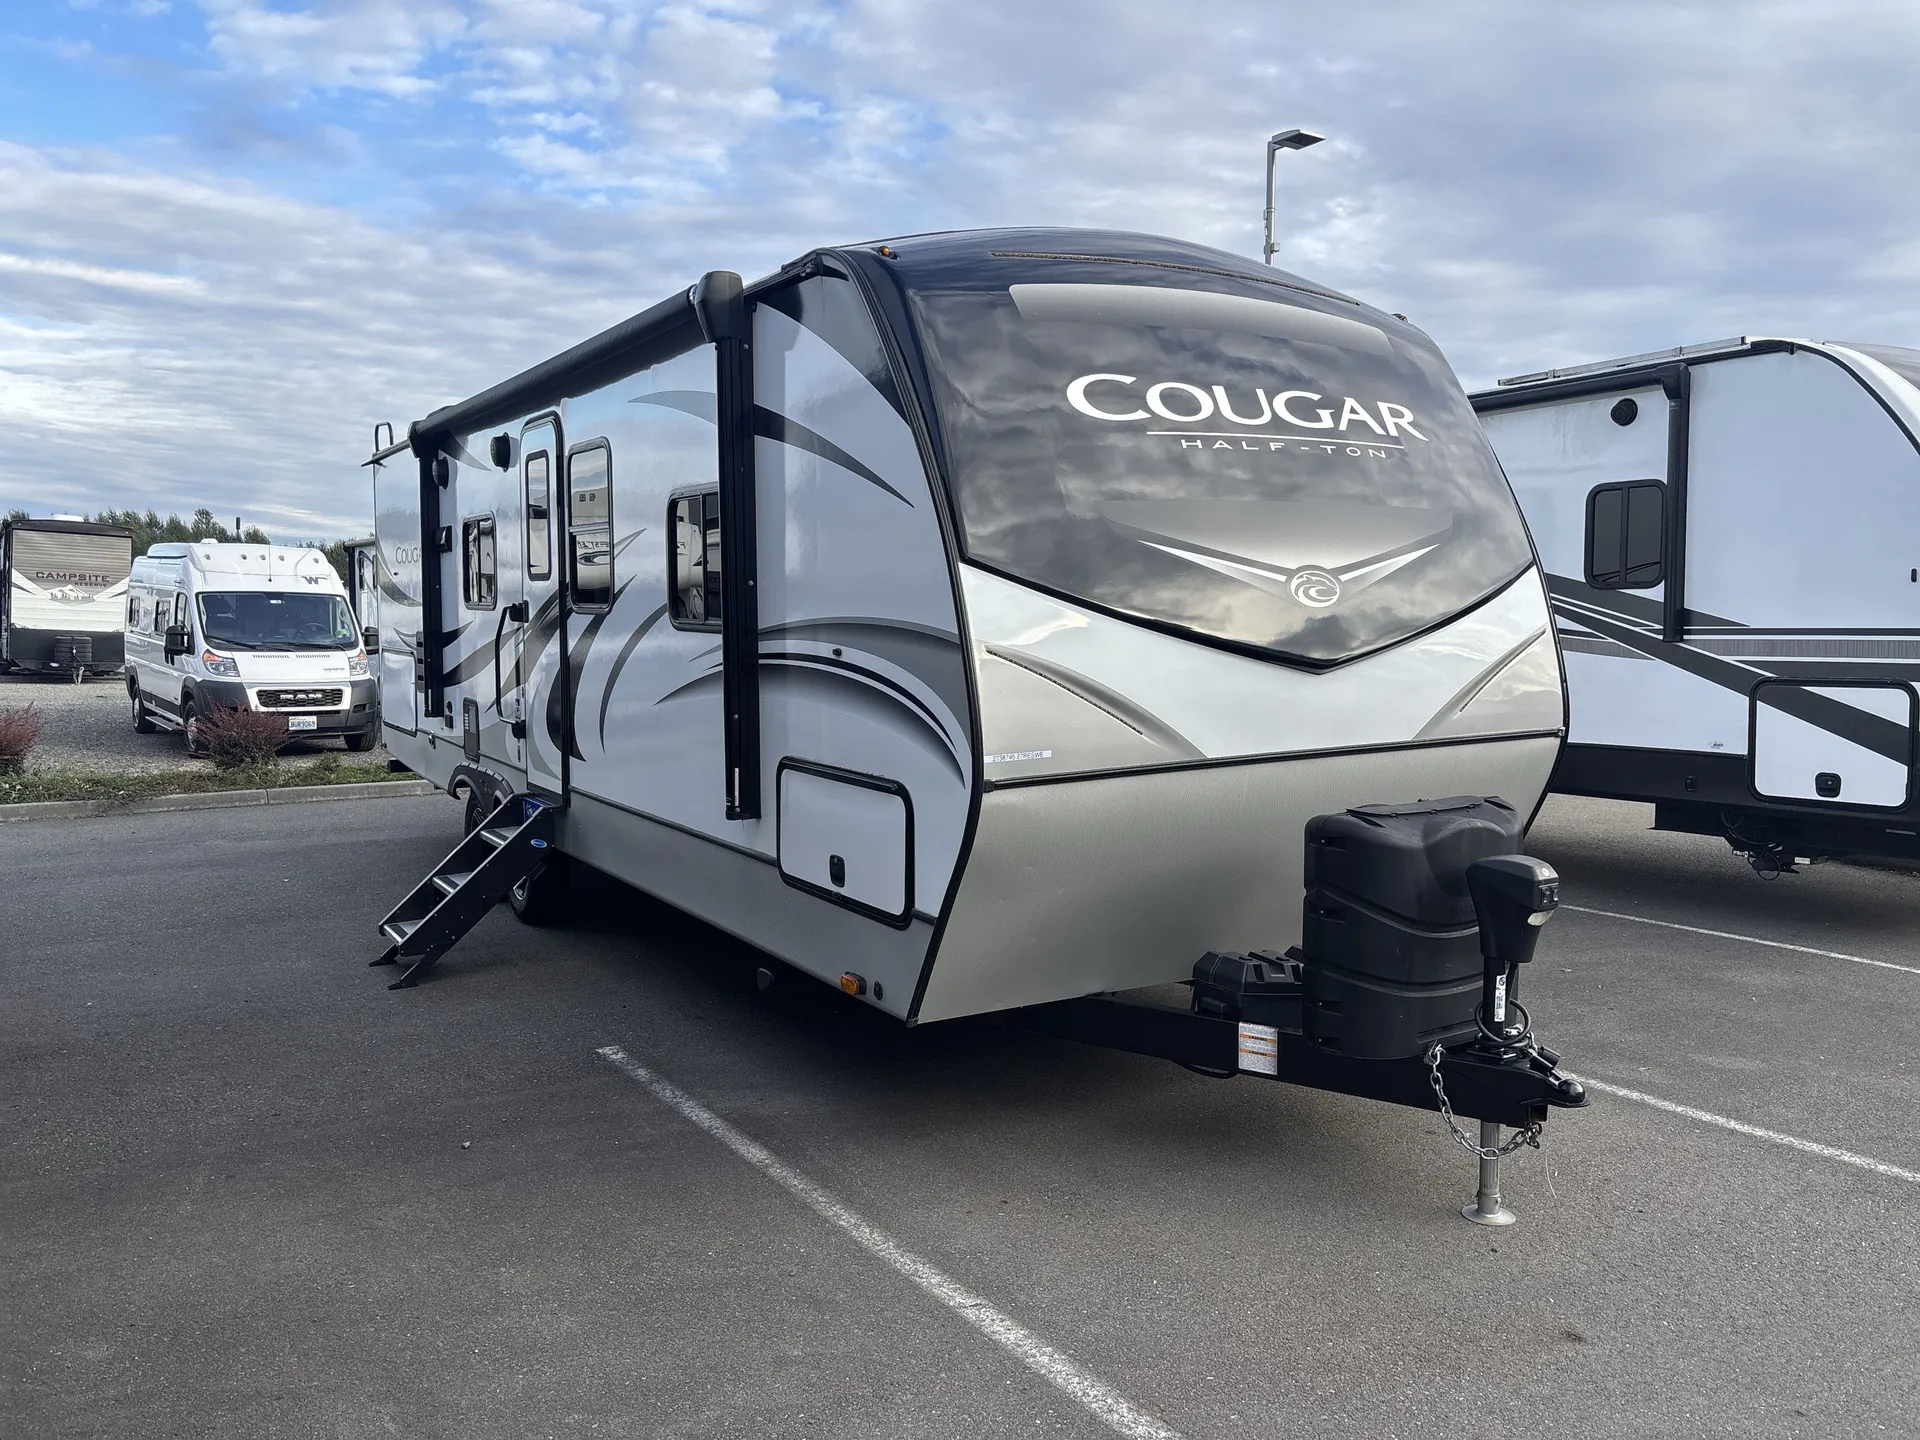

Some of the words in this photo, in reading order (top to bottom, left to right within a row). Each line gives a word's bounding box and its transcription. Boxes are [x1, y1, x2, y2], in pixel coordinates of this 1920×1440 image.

[1066, 373, 1430, 442] COUGAR
[1181, 438, 1387, 459] HALF-TON
[35, 571, 110, 582] CAMPSITE
[280, 693, 323, 701] RAM
